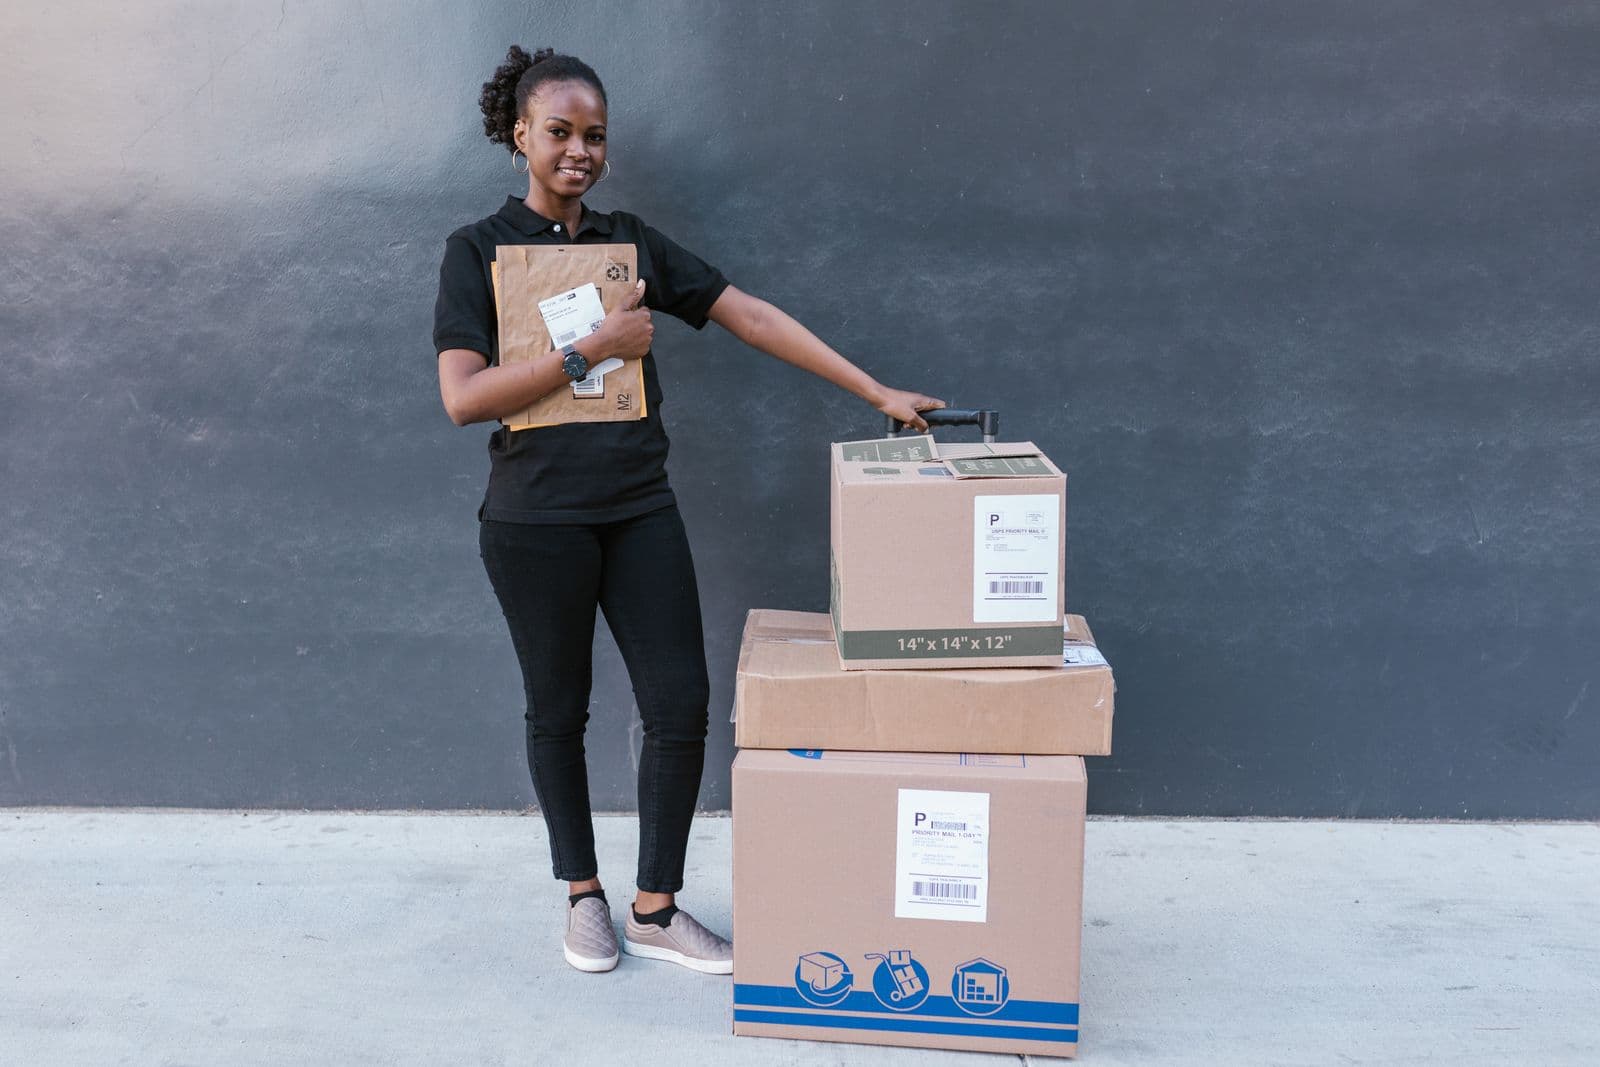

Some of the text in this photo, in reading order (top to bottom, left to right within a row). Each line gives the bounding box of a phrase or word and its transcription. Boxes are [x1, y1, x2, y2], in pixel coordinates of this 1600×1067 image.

[617, 393, 630, 411] M2
[990, 514, 1000, 526] P
[897, 635, 1012, 651] 14" x 14" x 12"
[914, 812, 926, 826] P
[912, 829, 940, 837] PRIORITY
